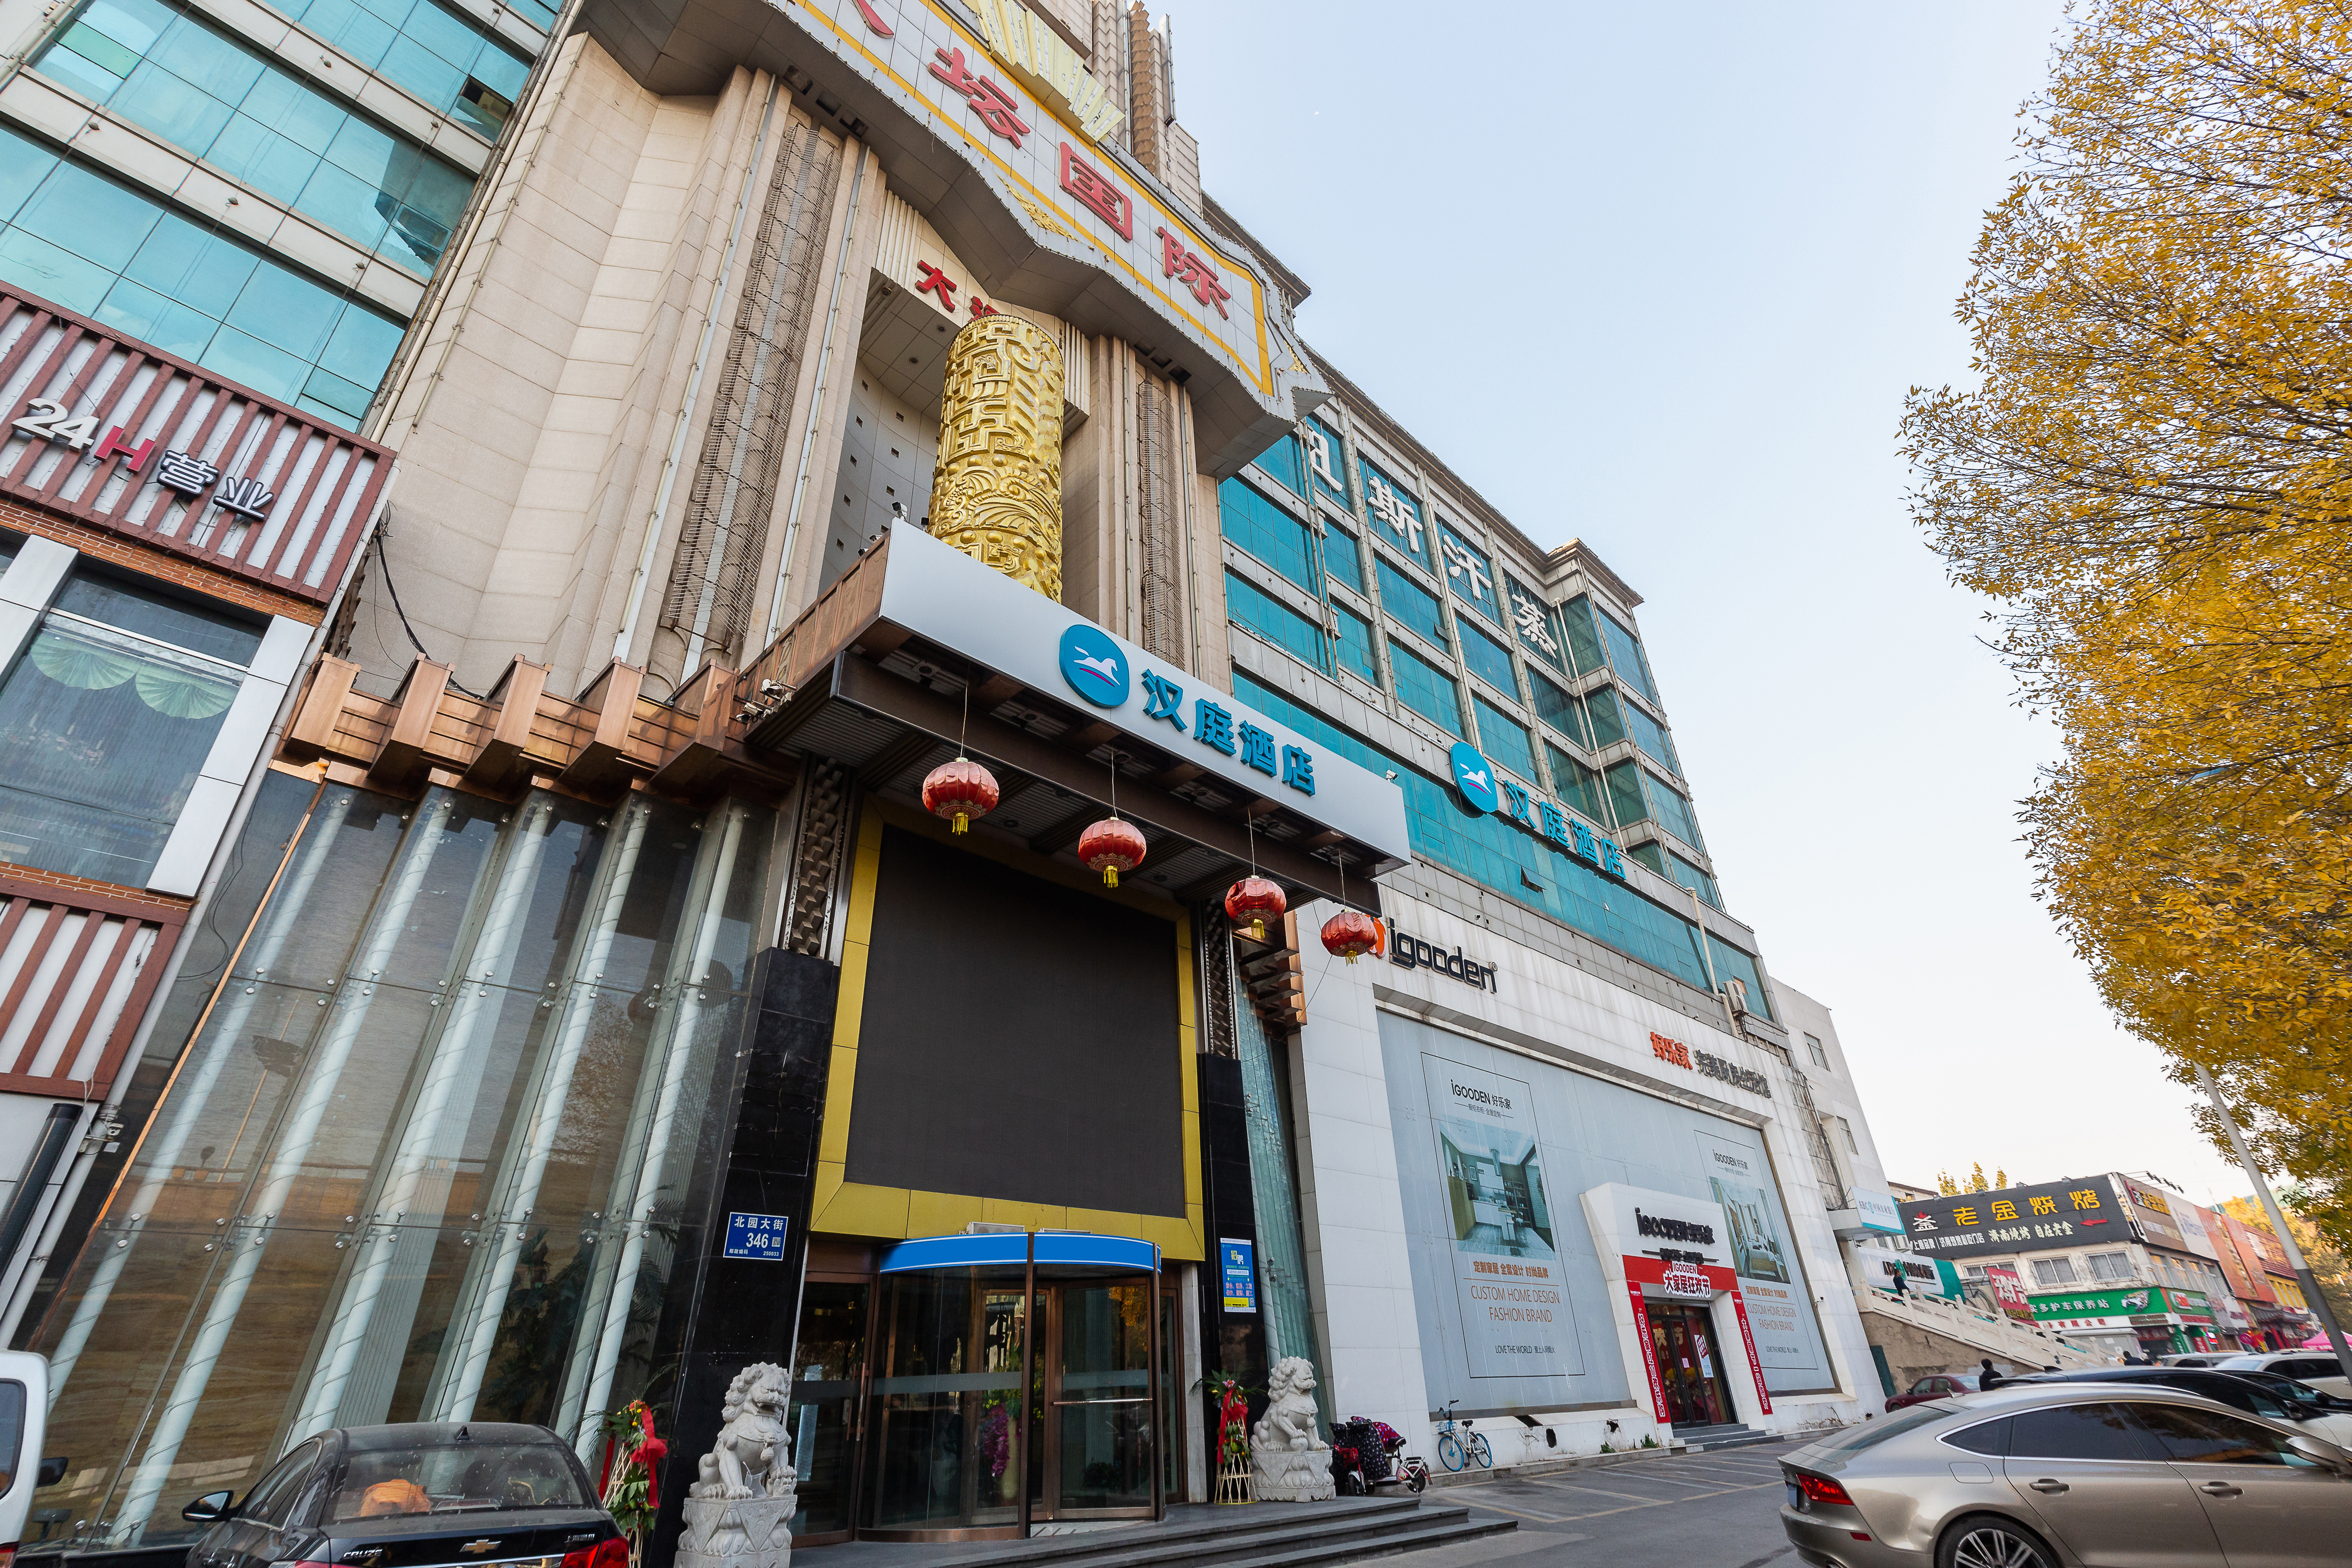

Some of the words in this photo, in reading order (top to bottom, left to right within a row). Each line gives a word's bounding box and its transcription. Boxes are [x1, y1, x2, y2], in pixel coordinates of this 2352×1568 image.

[853, 0, 1231, 320] 坛国际
[11, 397, 274, 521] 24H营业
[1141, 668, 1316, 797] 汉庭酒店
[1503, 780, 1627, 880] 汉庭酒店
[1650, 1031, 1693, 1070] 好乐家
[1450, 1079, 1491, 1105] iGOODEN
[1491, 1094, 1512, 1110] 好乐家
[1712, 1149, 1737, 1167] iGOODEN
[1859, 1200, 1869, 1210] ABC
[1952, 1189, 2101, 1226] 老金烧烤
[734, 1216, 783, 1230] 北园大街
[746, 1232, 769, 1248] 346
[1473, 1261, 1500, 1275] 定制家居
[1500, 1263, 1524, 1276] 全案设计
[1525, 1266, 1549, 1279] 时尚品牌
[1674, 1263, 1697, 1274] IGOODEN
[1665, 1272, 1710, 1296] 大家居狂欢节
[1471, 1285, 1506, 1301] CUSTOM
[1507, 1288, 1532, 1302] HOME
[1532, 1290, 1560, 1304] DESIGN
[1489, 1307, 1525, 1322] FASHION
[1526, 1309, 1552, 1322] BRAND
[1747, 1303, 1767, 1315] CUSTOM
[1767, 1306, 1781, 1316] HOME
[1780, 1307, 1797, 1318] DESIGN
[1758, 1319, 1780, 1330] FASHION
[1779, 1320, 1794, 1331] BRAND
[1495, 1345, 1507, 1354] LOVE
[1507, 1345, 1516, 1354] THE
[1516, 1345, 1532, 1354] WORLD
[342, 1549, 383, 1560] CRUZE
